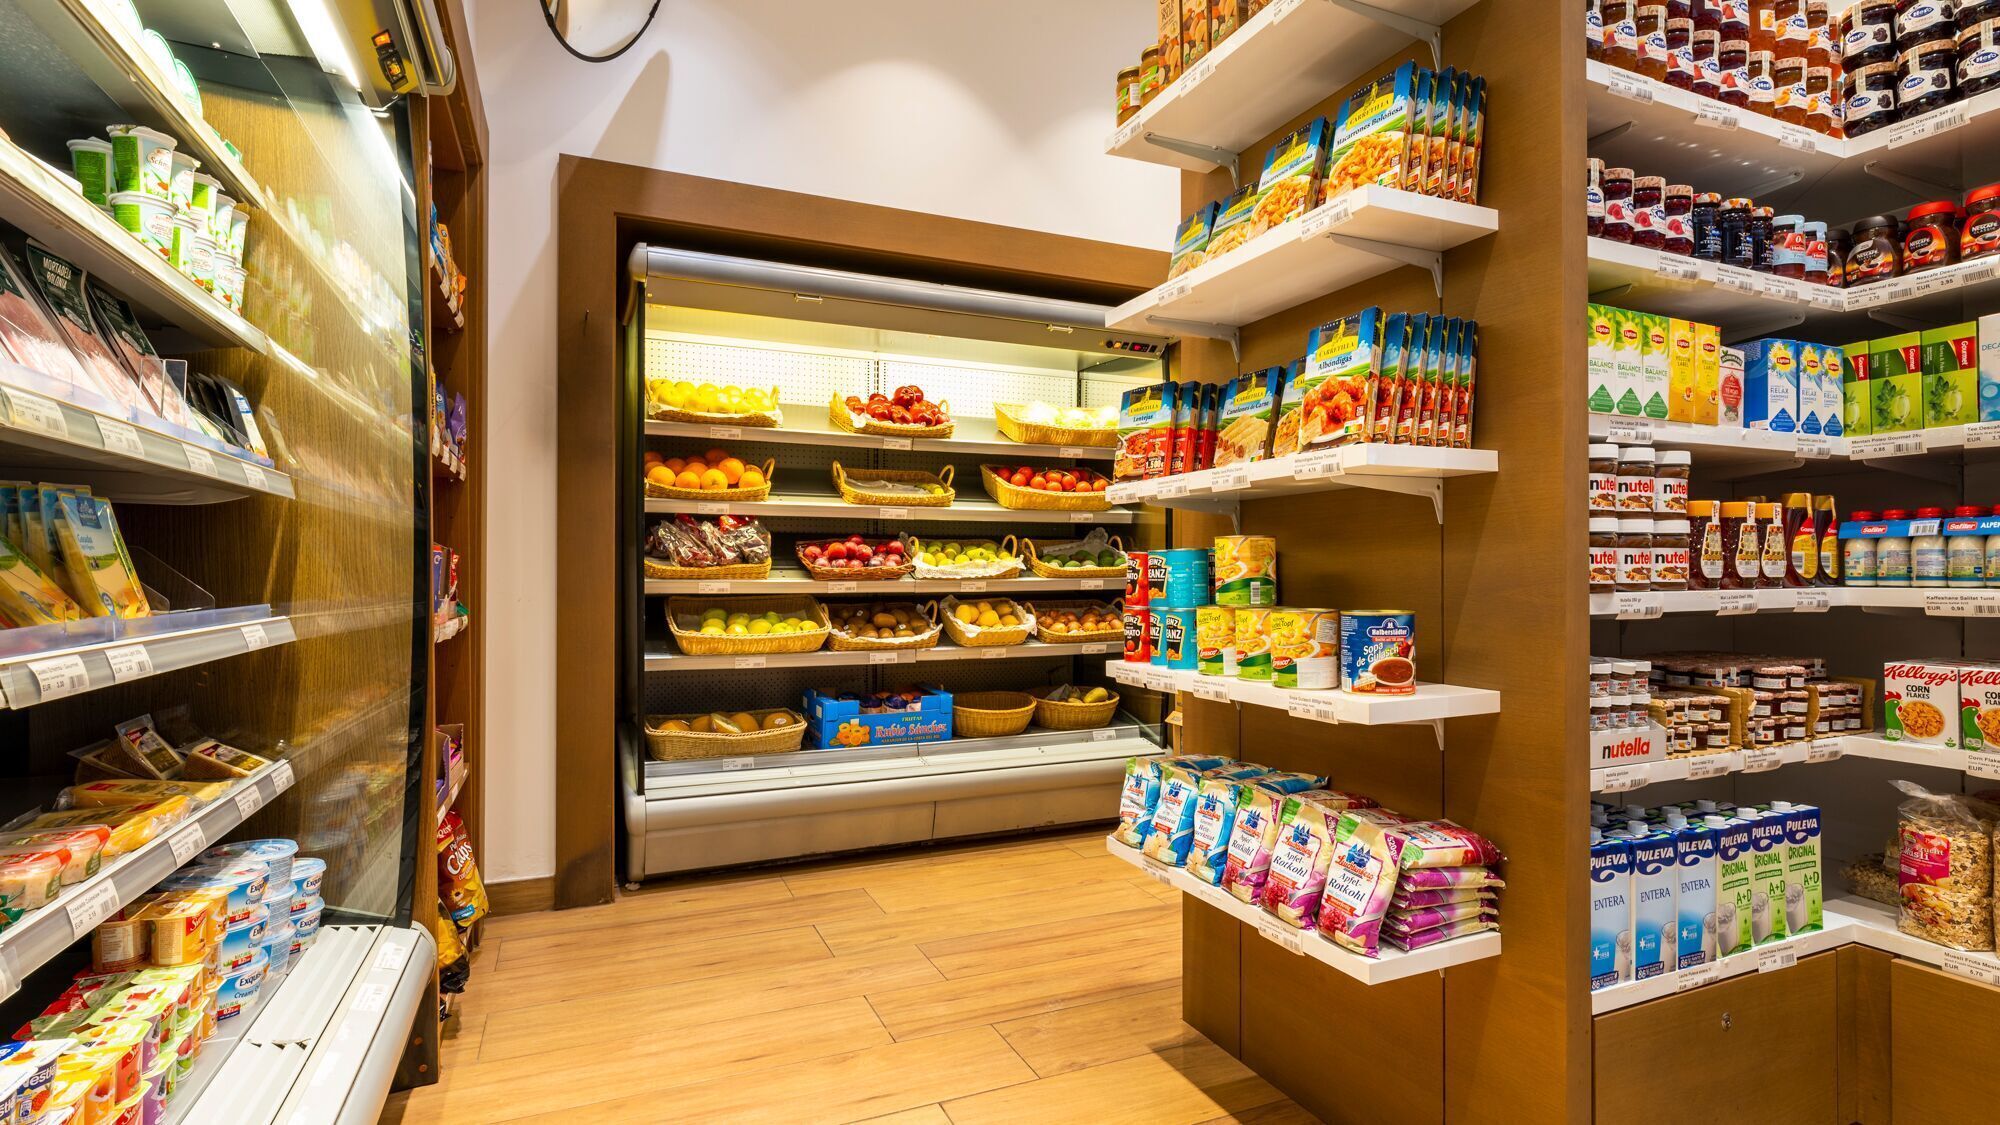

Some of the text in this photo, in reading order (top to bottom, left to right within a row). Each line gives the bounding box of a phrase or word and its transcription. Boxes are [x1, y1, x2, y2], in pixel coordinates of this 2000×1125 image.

[1911, 7, 1934, 18] Hero
[1848, 32, 1866, 43] Hero
[1973, 52, 1999, 63] Hero
[1904, 77, 1924, 88] Hero
[1851, 97, 1871, 107] Hero
[1349, 98, 1390, 126] CARRETILLA
[1337, 104, 1403, 147] Macarrones Boloñesa
[1889, 135, 1903, 144] EUR
[1596, 325, 1610, 334] Lipton
[1624, 332, 1638, 340] Lipton
[1652, 336, 1664, 344] Lipton
[1677, 340, 1690, 348] Lipton
[1318, 342, 1357, 359] CARRETILLA
[1961, 340, 1969, 367] Gourmet
[1318, 355, 1353, 372] Albóndigas
[1589, 359, 1614, 370] BALANCE
[1617, 363, 1641, 373] BALANCE
[1777, 358, 1790, 366] Lipton
[1807, 360, 1819, 368] Lipton
[1645, 367, 1668, 377] BALANCE
[1236, 391, 1265, 404] CARRETILLA
[1770, 387, 1789, 395] RELAX
[1802, 389, 1817, 397] RELAX
[1130, 404, 1160, 414] CARRETILLA
[1226, 406, 1249, 416] Canelones
[1133, 414, 1153, 423] Lentejas
[1590, 477, 1616, 491] nutel
[1618, 478, 1654, 493] nutell
[1949, 522, 1976, 531] Saliter
[1589, 550, 1617, 564] nutel
[1655, 550, 1689, 564] nutell
[1209, 614, 1221, 625] Topf
[1281, 619, 1294, 630] Topf
[1124, 629, 1141, 638] OMATO
[1371, 627, 1408, 637] Halberstädter
[1356, 645, 1400, 668] de Gulasch
[1363, 642, 1384, 657] Sopa
[1884, 664, 1957, 686] Kellogg's
[1906, 684, 1930, 694] CORN
[1906, 691, 1930, 699] FLAKES
[1985, 691, 2000, 700] CO
[875, 720, 947, 738] Rubio Sánchez
[1602, 737, 1650, 760] nutella
[1752, 825, 1783, 839] PULEVA
[1786, 818, 1818, 833] PULEVA
[1720, 832, 1748, 849] PULEVA
[1231, 840, 1255, 856] Rotkohl
[1637, 846, 1674, 864] PULEVA
[1788, 844, 1816, 860] ORIGINAL
[1273, 855, 1308, 877] Rotkohl
[1591, 852, 1627, 870] PULEVA
[1754, 852, 1781, 868] ORIGINAL
[1722, 860, 1748, 878] ORIGINAL
[1338, 871, 1362, 888] Apfel-
[1681, 878, 1710, 893] ENTERA
[1803, 871, 1820, 887] A+D
[1328, 878, 1366, 902] Rotkohl
[1769, 880, 1786, 895] A+D
[1640, 887, 1671, 903] ENTERA
[1736, 889, 1752, 905] A+D
[1594, 894, 1625, 911] ENTERA
[234, 989, 254, 999] Creamy
